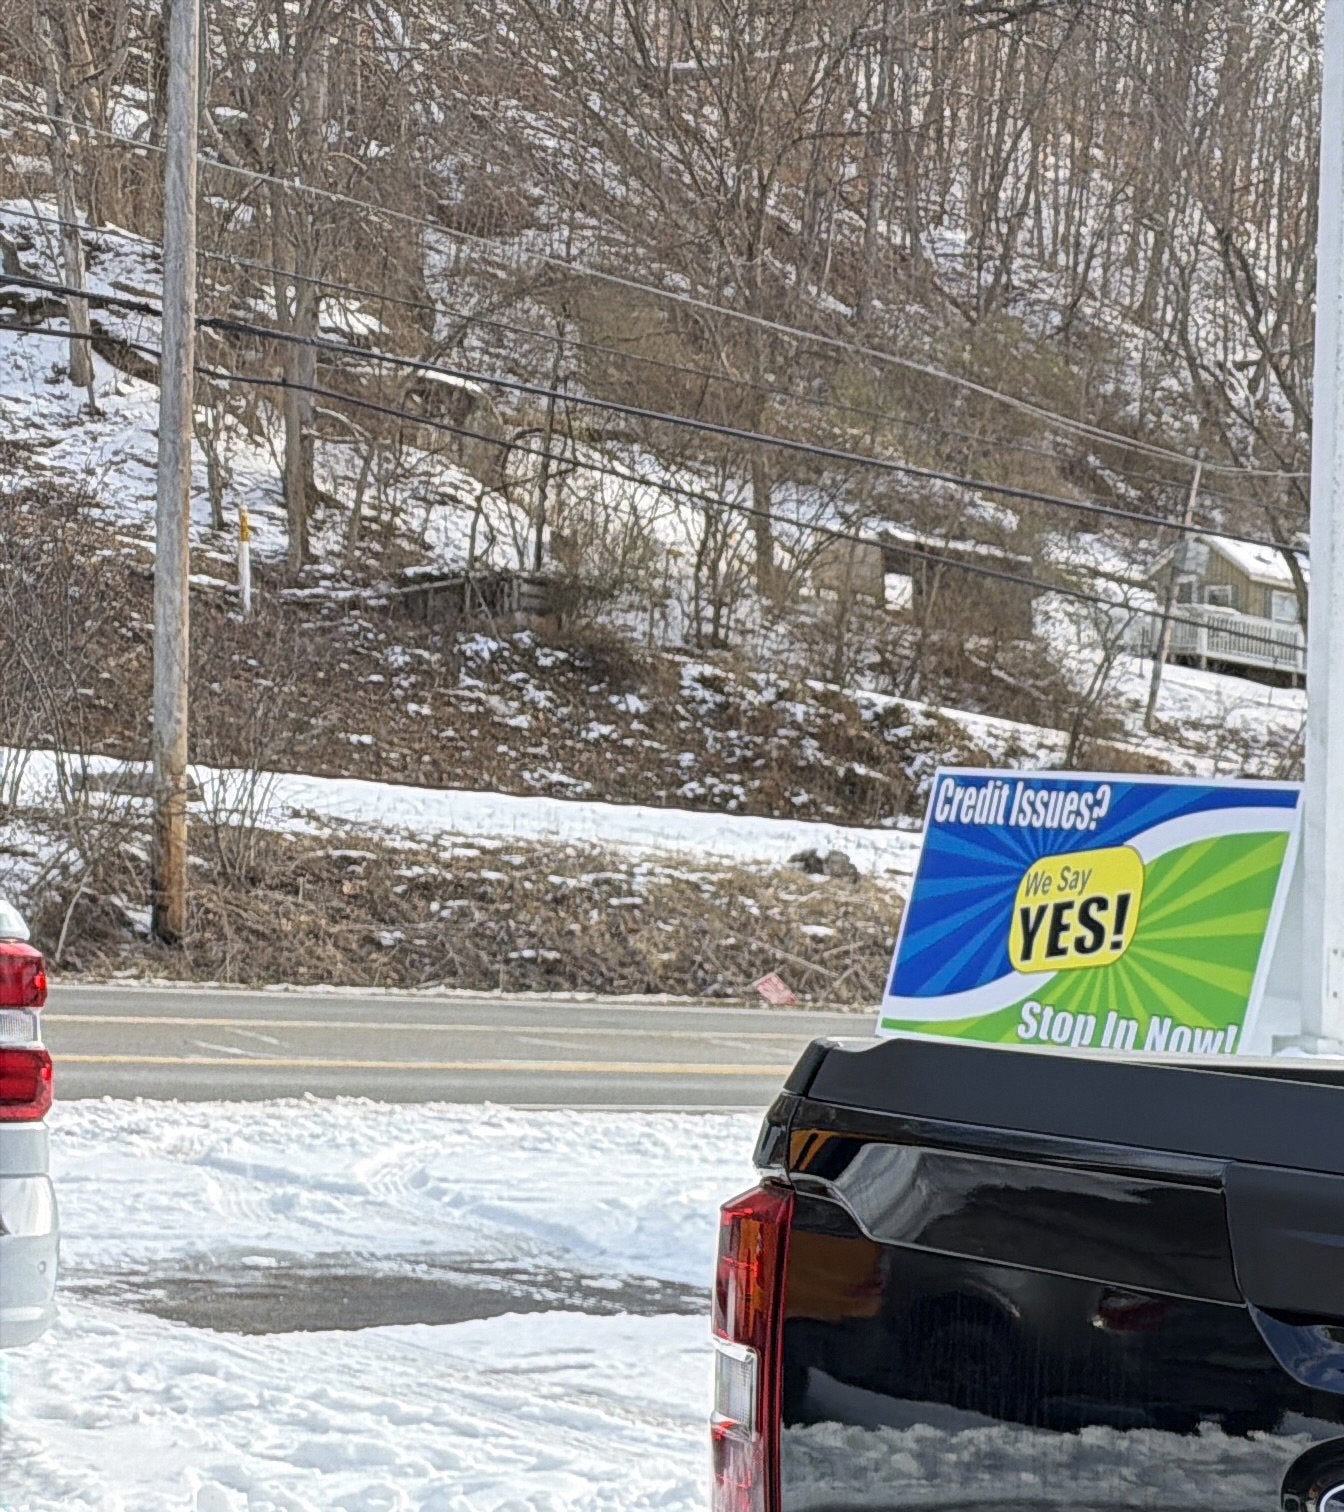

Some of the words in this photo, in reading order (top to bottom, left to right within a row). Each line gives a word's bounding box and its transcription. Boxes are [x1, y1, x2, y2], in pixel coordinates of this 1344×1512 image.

[935, 778, 1010, 825] Credit
[1009, 781, 1111, 831] Issues?
[1025, 870, 1052, 897] We
[1057, 866, 1092, 896] Say
[1020, 893, 1131, 962] YES!
[1017, 1000, 1096, 1048] Stop
[1101, 1011, 1138, 1050] In
[1144, 1016, 1238, 1054] Now!
